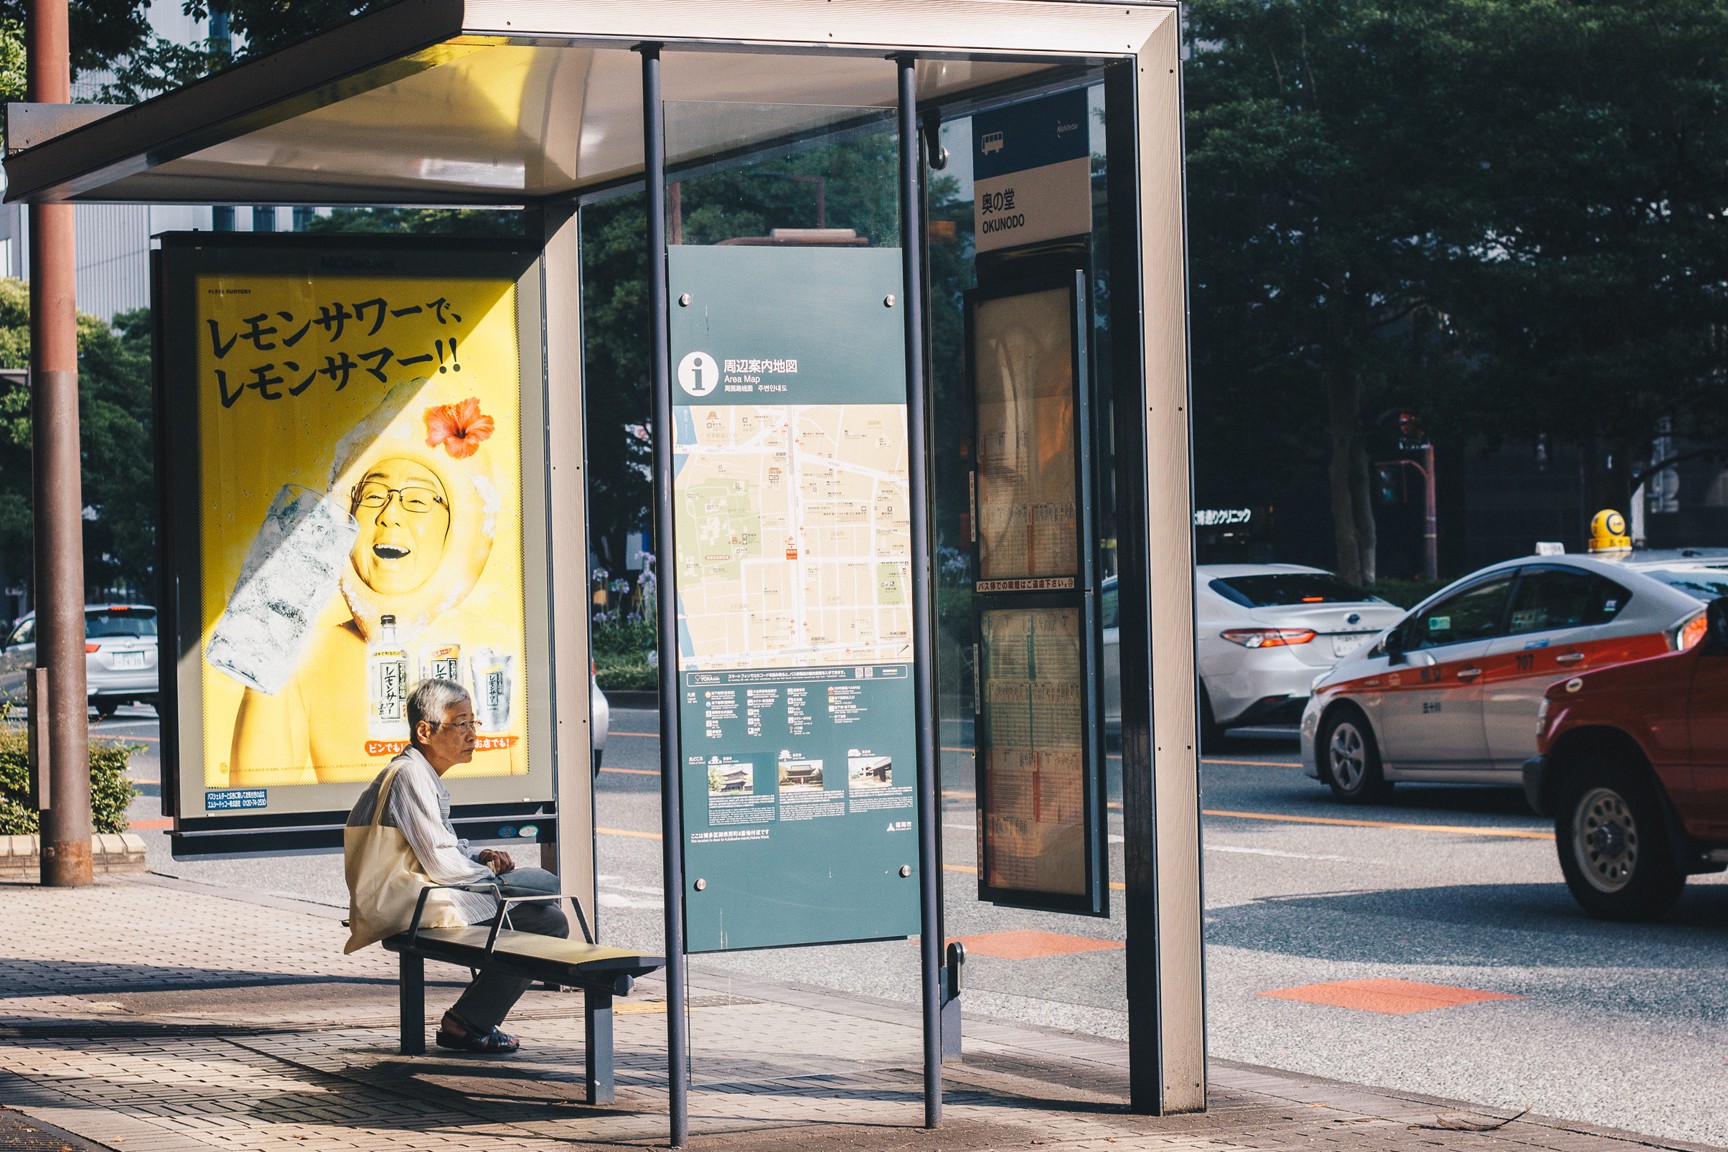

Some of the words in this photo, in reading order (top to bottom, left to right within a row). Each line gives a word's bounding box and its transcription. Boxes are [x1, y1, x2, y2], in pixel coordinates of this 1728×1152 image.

[982, 188, 1015, 215] 奥の堂
[983, 213, 1025, 234] OKUNODO
[207, 297, 462, 359] レモンサワーで、
[215, 337, 461, 409] レモンサマー!!
[723, 359, 798, 373] 周辺案内地図
[724, 375, 742, 383] Area
[744, 375, 760, 384] Map
